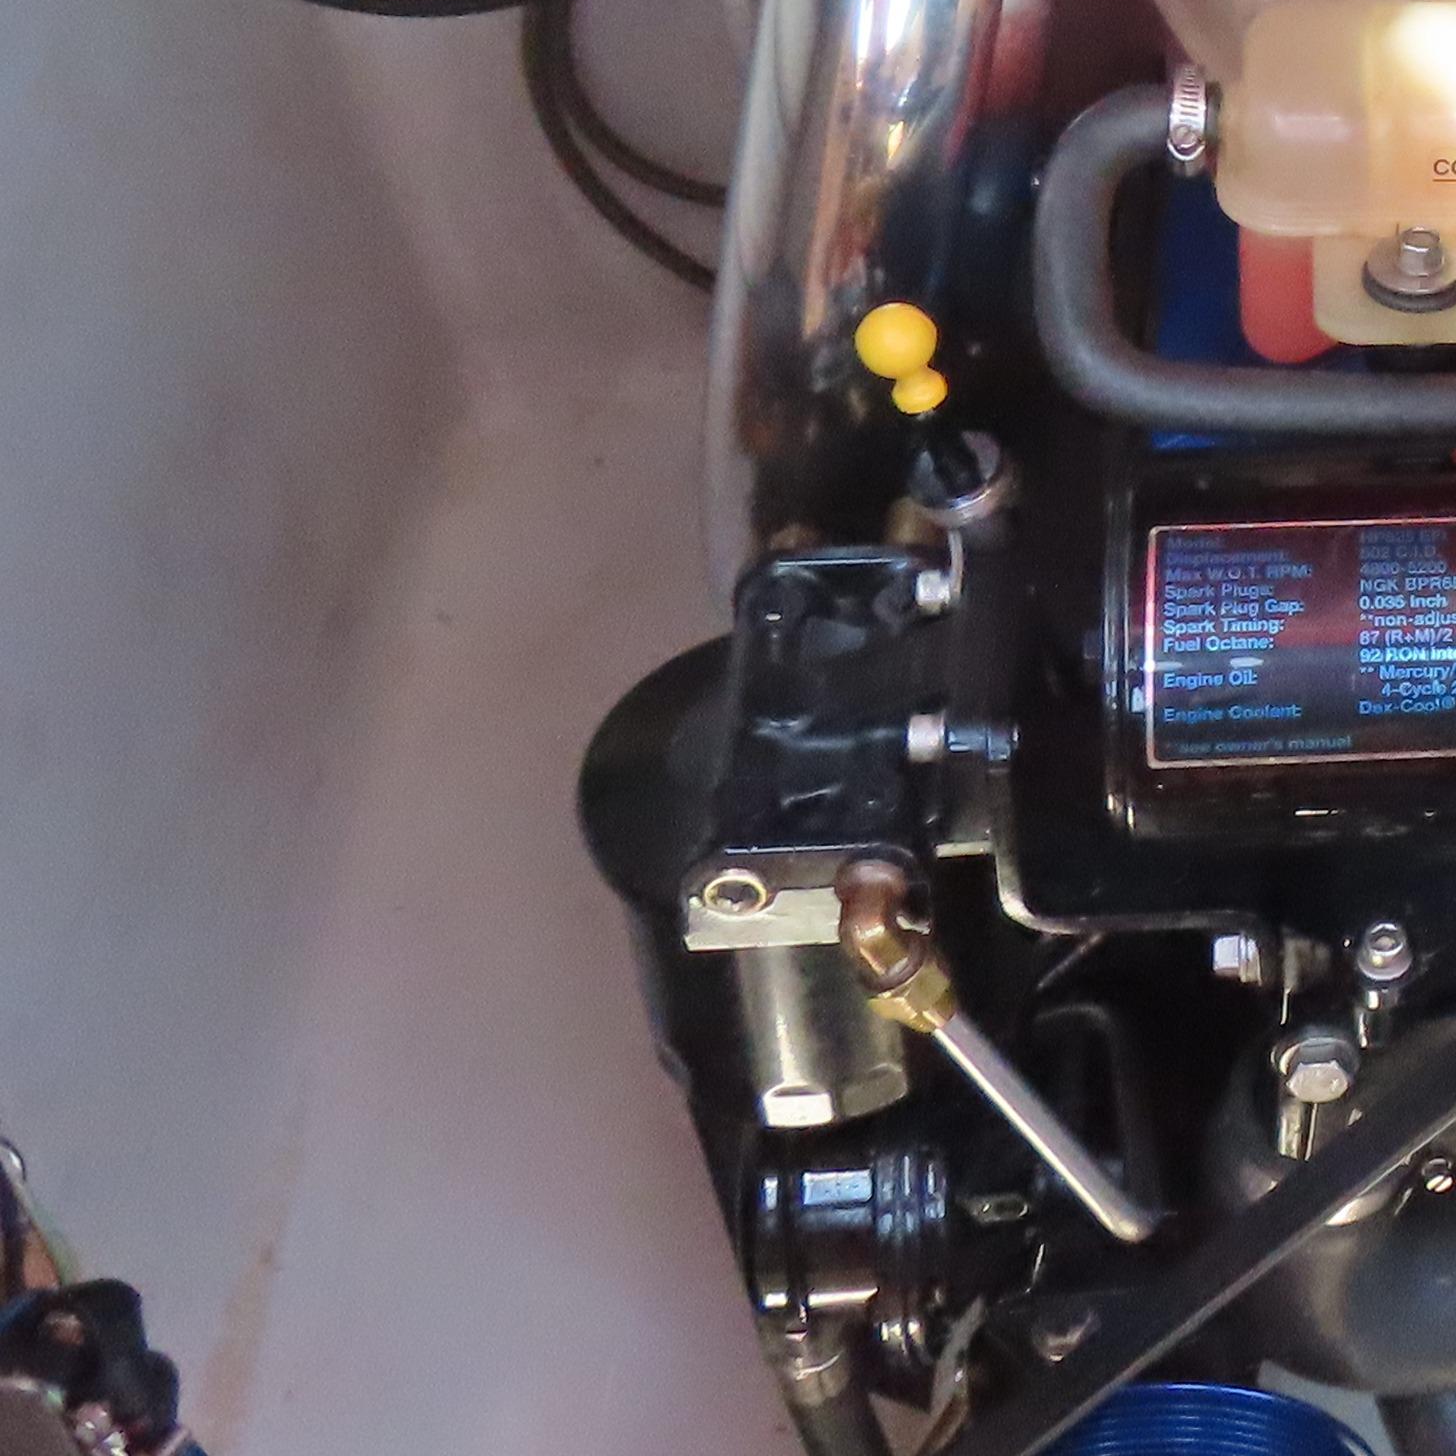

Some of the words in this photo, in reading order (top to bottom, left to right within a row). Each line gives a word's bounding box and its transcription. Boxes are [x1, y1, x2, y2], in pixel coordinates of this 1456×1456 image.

[1164, 585, 1215, 601] Spark
[1220, 582, 1275, 599] Plugs:
[1359, 578, 1398, 593] NGK
[1163, 601, 1216, 618] Spark
[1220, 600, 1260, 617] Plug
[1264, 598, 1305, 616] Gap:
[1409, 593, 1448, 609] inch
[1162, 619, 1216, 636] Spark
[1219, 617, 1286, 634] Timing:
[1162, 637, 1200, 653] Fuel
[1205, 635, 1275, 651] Octane:
[1359, 648, 1383, 663] 92
[1162, 672, 1224, 691] Engine
[1228, 669, 1259, 686] Oil:
[1381, 680, 1448, 699] 4-Cycle
[1163, 707, 1224, 725] Engine
[1227, 703, 1303, 721] Coolant:
[1287, 734, 1353, 751] manual
